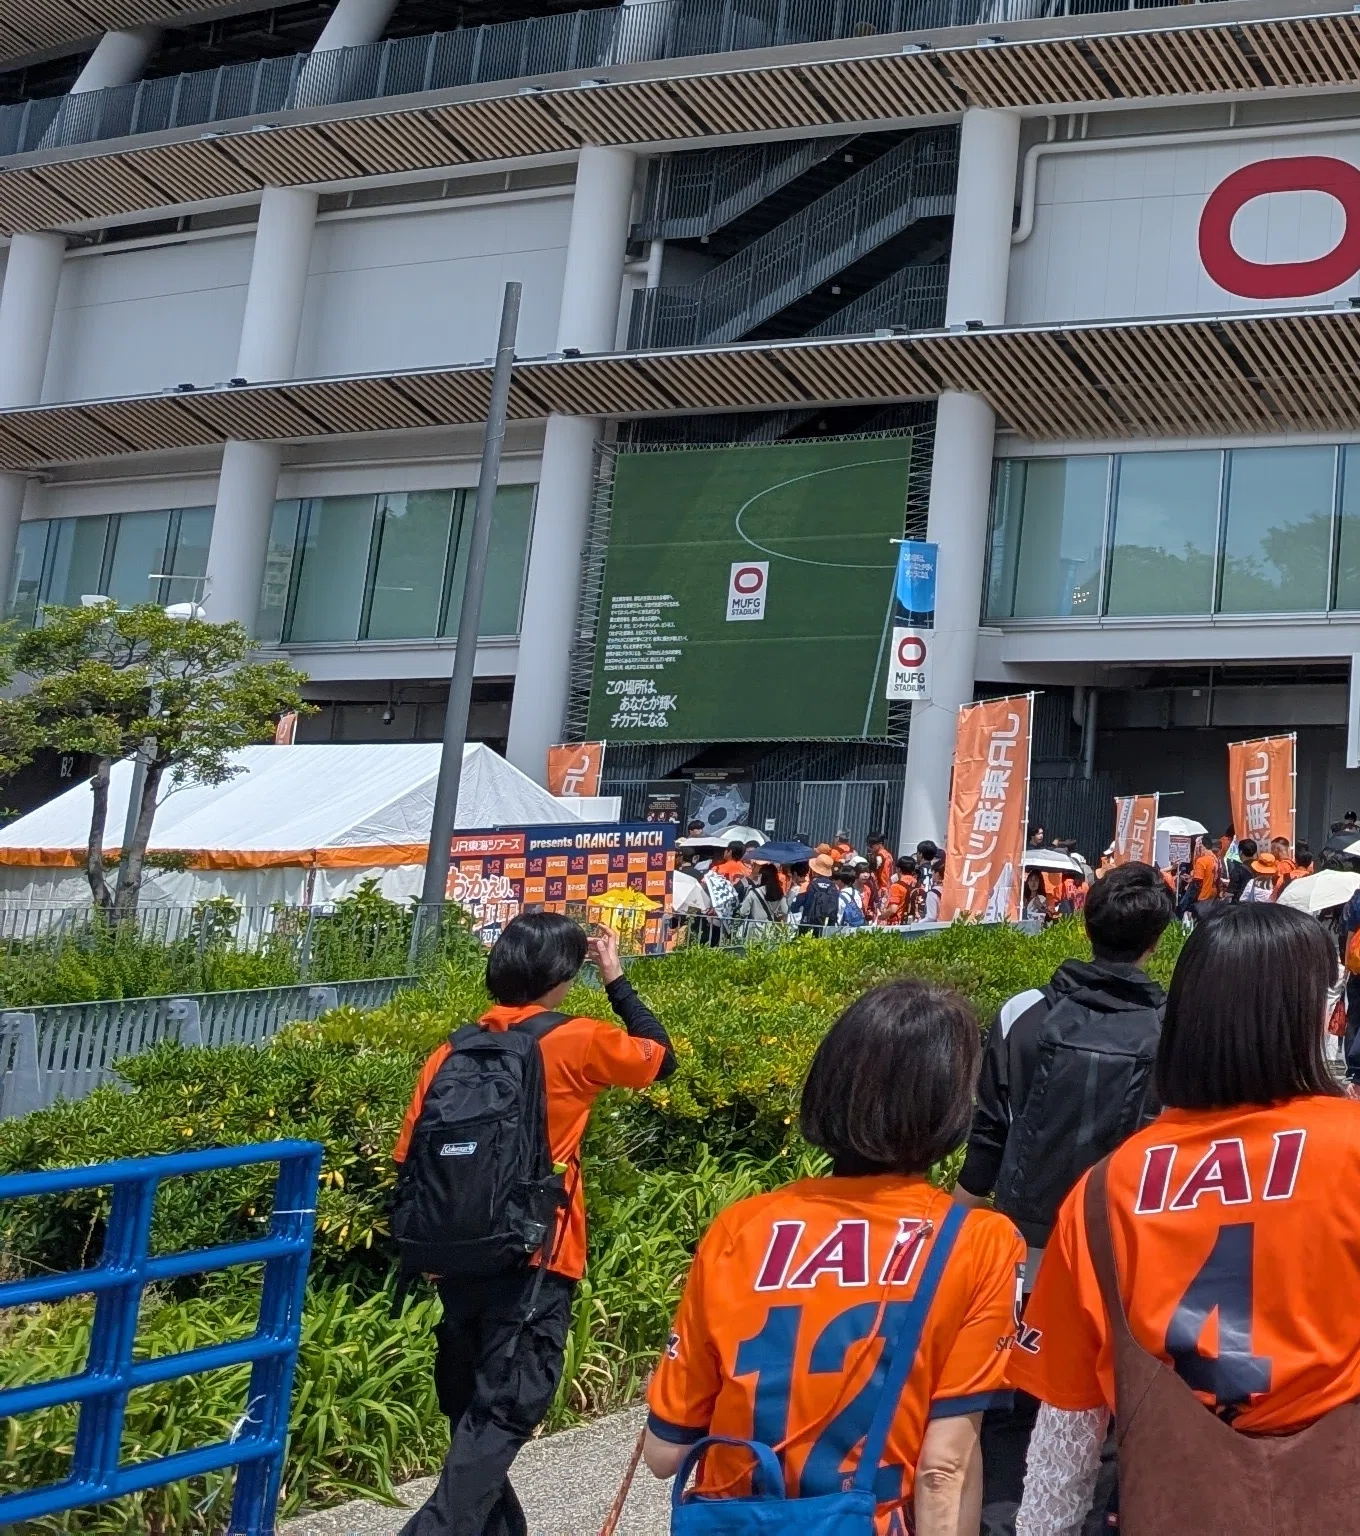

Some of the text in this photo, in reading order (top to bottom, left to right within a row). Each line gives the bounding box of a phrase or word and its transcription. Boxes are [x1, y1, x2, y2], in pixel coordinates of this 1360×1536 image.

[731, 608, 760, 616] STADIUM
[732, 598, 760, 608] MUFG
[894, 684, 926, 692] STADIUM
[895, 672, 925, 684] MUFG
[60, 756, 74, 777] B2
[451, 830, 664, 853] JR東海ツアーズ presents ORANGE MATCH
[1134, 1129, 1306, 1214] IAI
[754, 1218, 930, 1291] IAI
[1165, 1221, 1273, 1405] 4
[732, 1300, 914, 1504] 12
